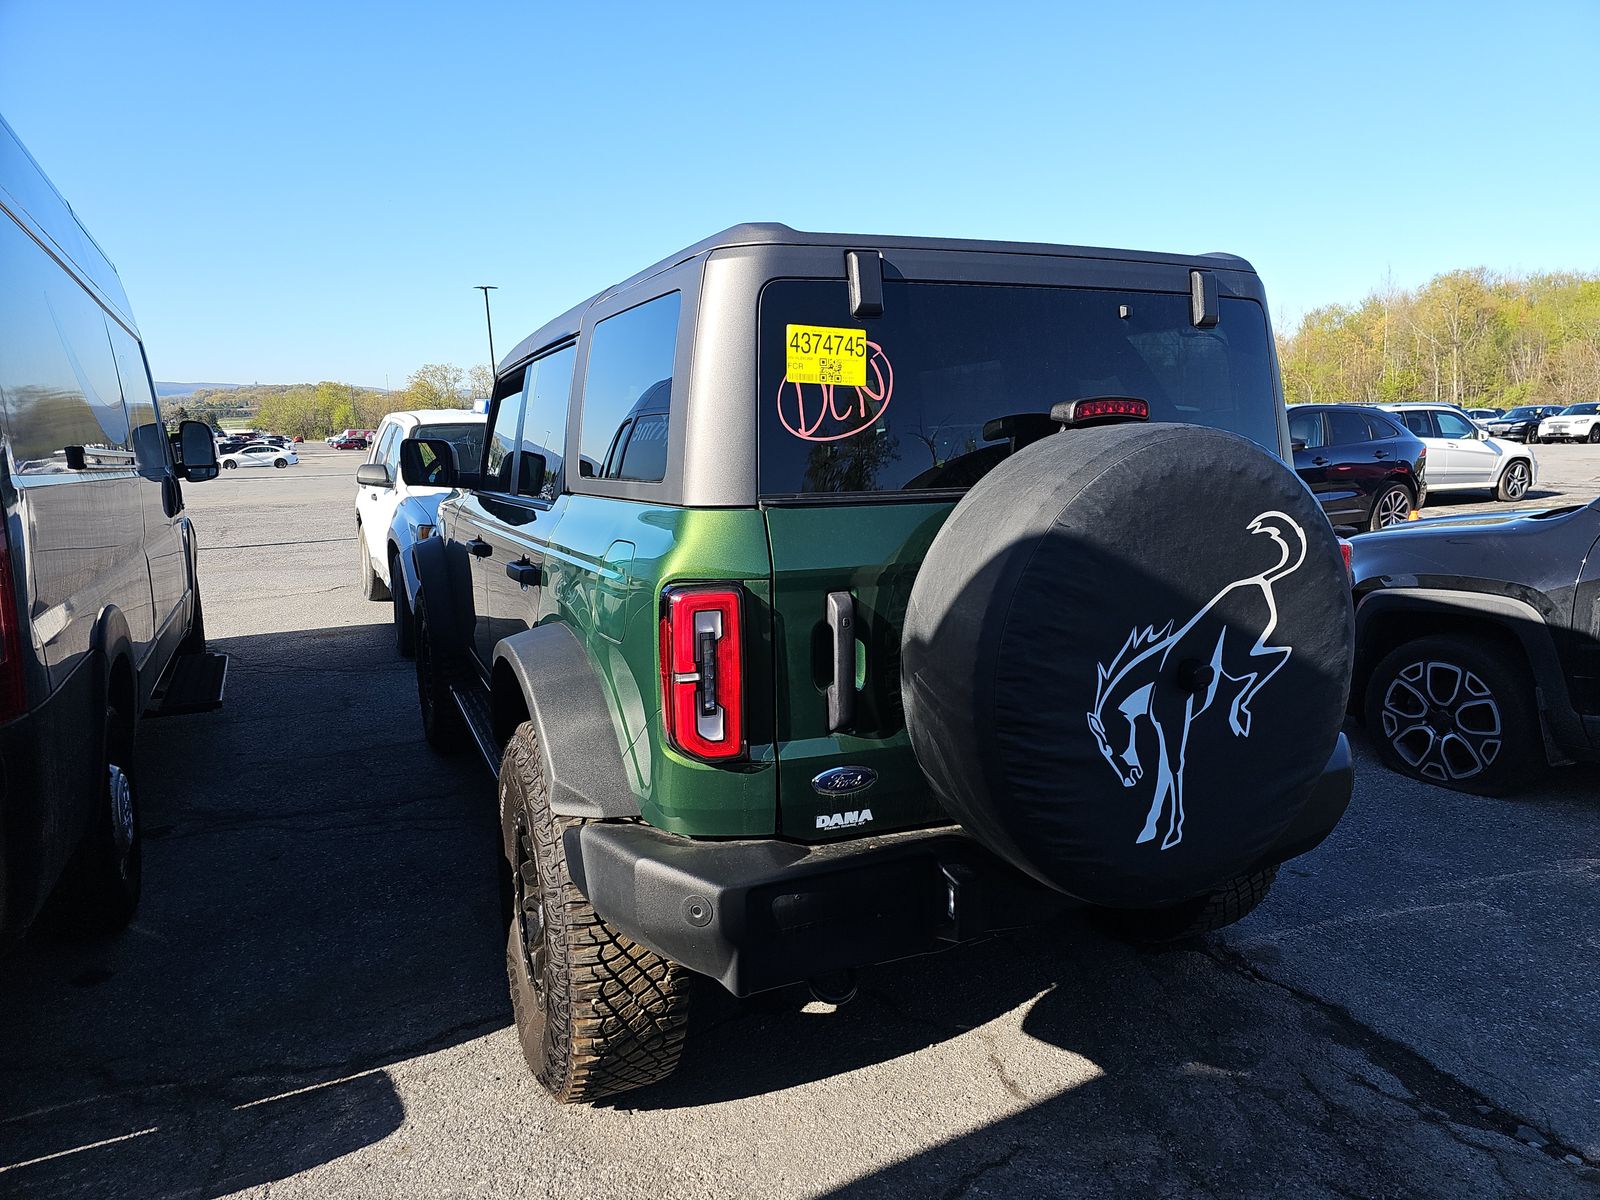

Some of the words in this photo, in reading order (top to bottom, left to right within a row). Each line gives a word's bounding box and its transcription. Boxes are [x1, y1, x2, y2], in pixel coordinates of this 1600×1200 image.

[789, 332, 865, 357] 4374745
[788, 362, 804, 370] FCR
[828, 772, 862, 789] Ford
